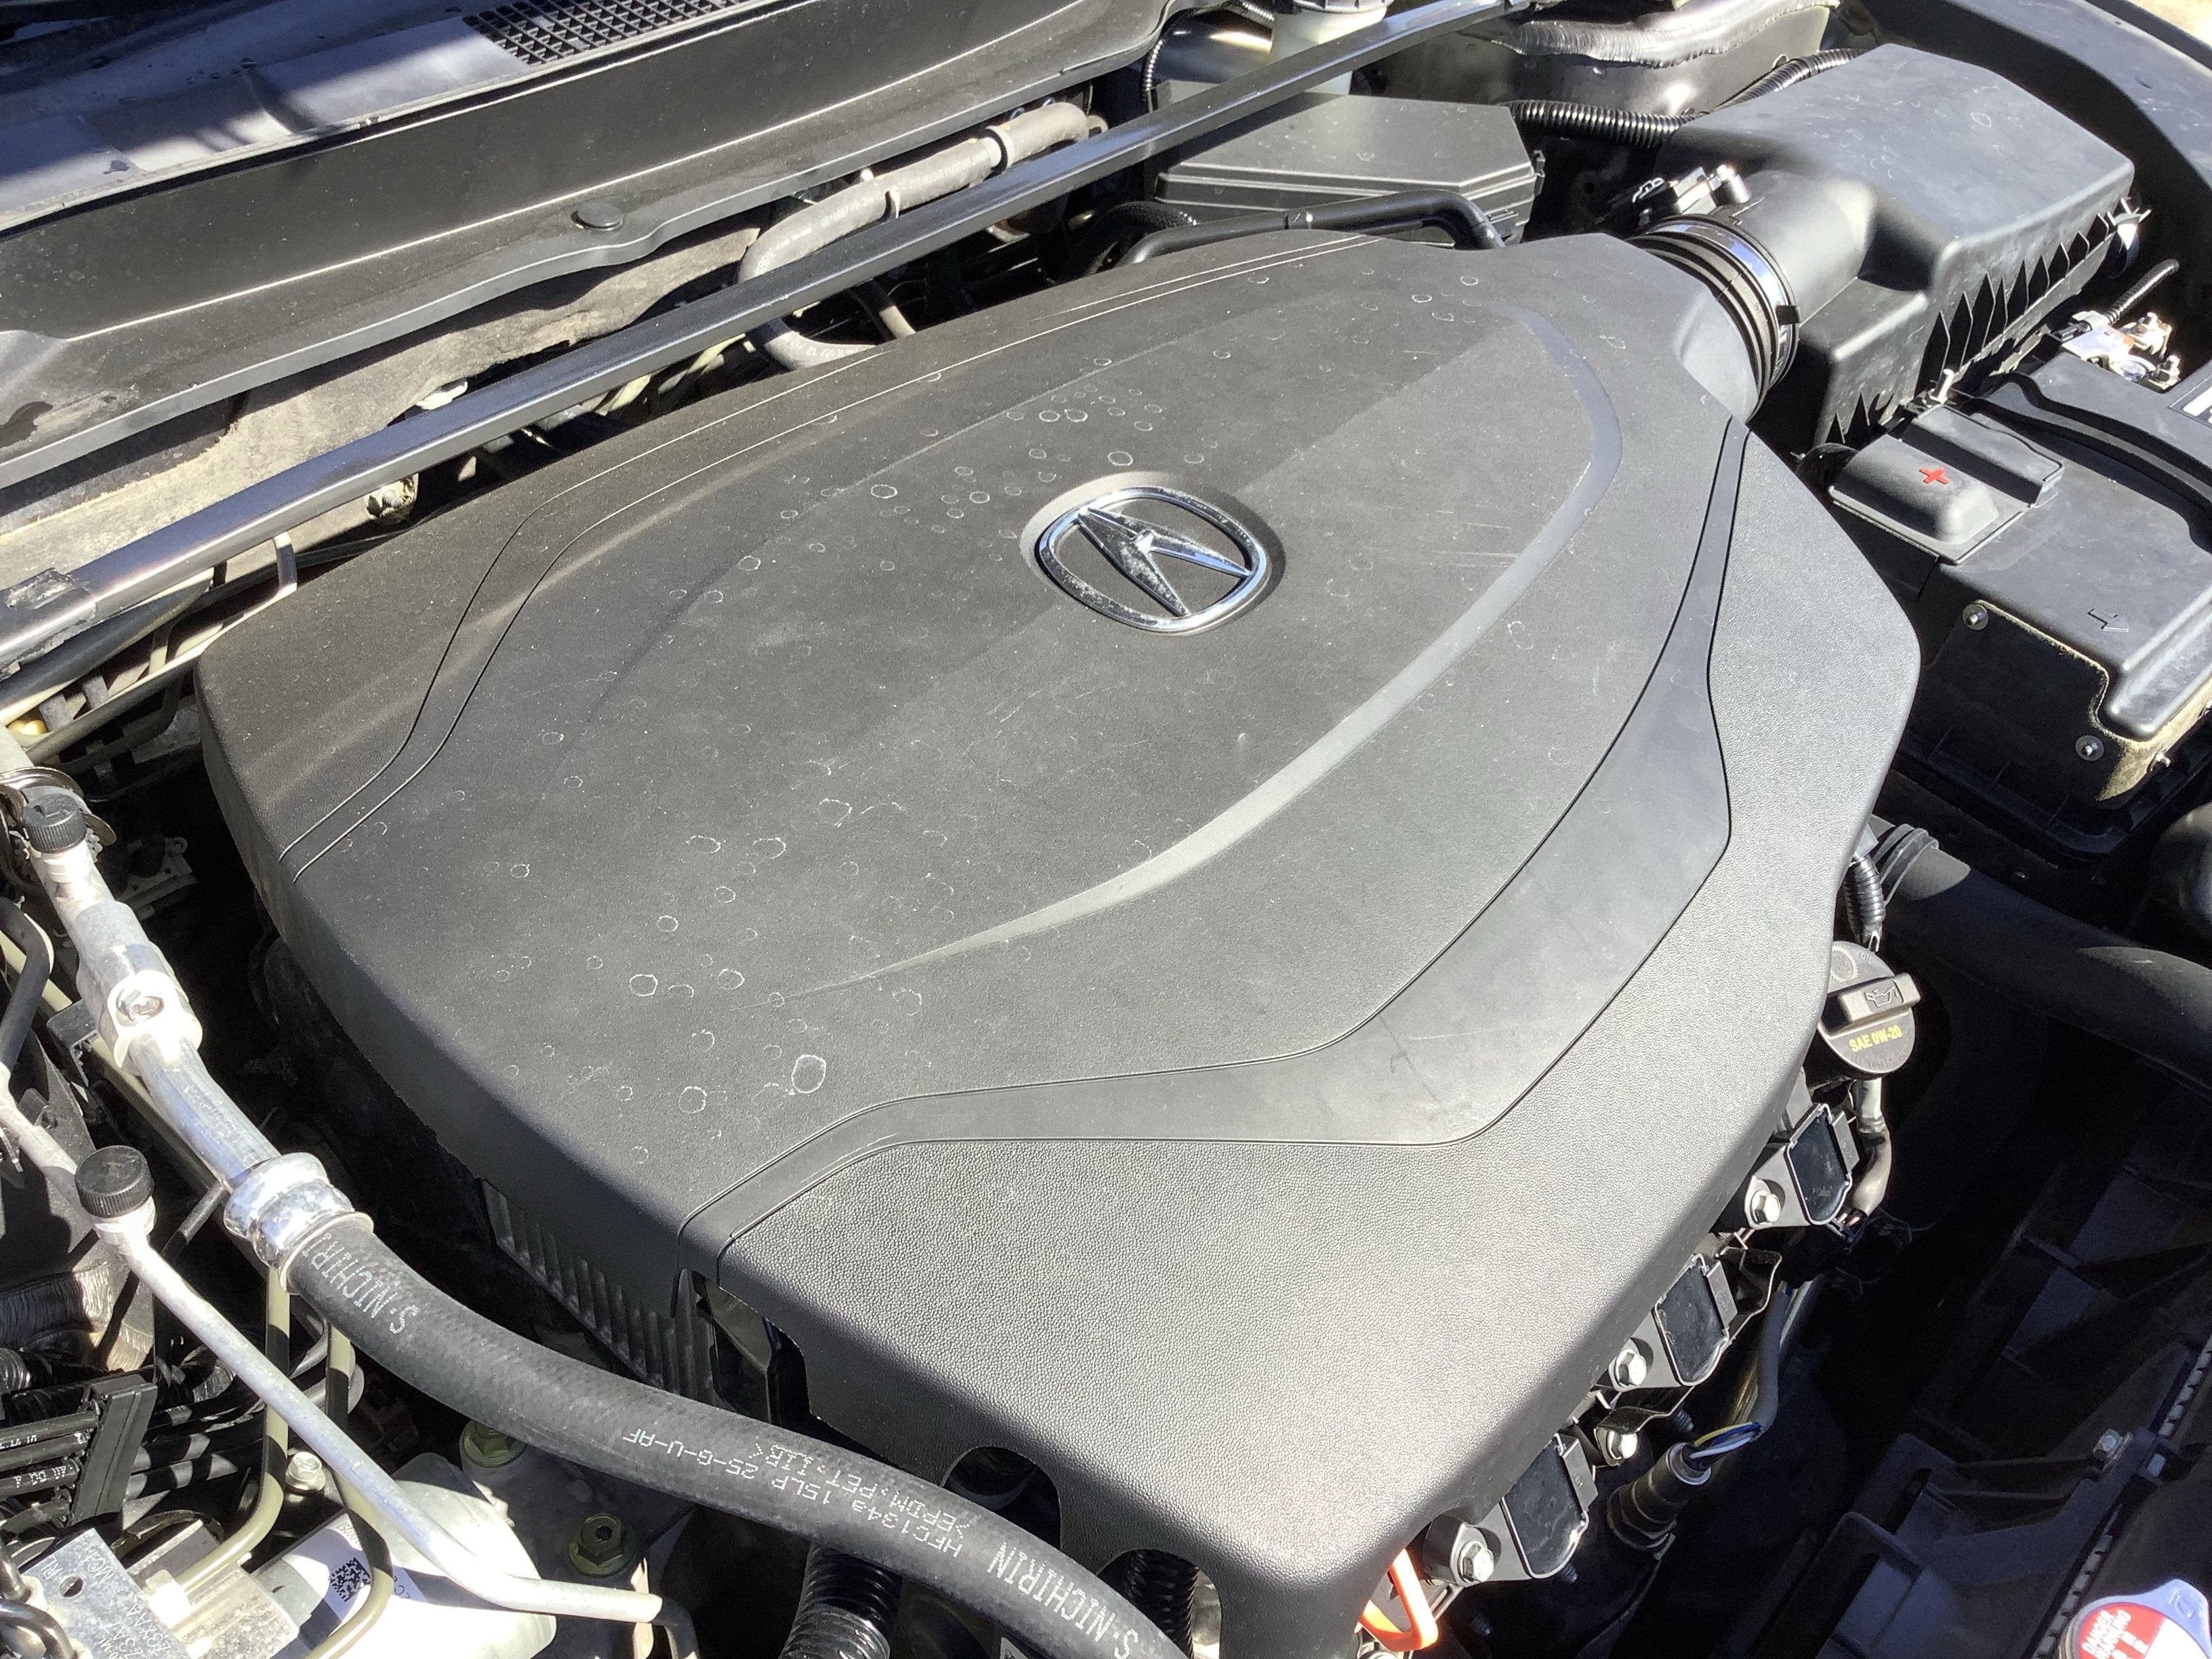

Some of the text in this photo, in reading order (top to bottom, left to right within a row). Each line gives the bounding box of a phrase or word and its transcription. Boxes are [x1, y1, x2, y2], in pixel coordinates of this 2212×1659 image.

[1849, 1024, 1902, 1052] SAE 0W-20
[771, 1475, 830, 1504] 15LP
[851, 1499, 962, 1557] HFC134a
[41, 1554, 63, 1580] RL
[2081, 1610, 2114, 1656] DANGER
